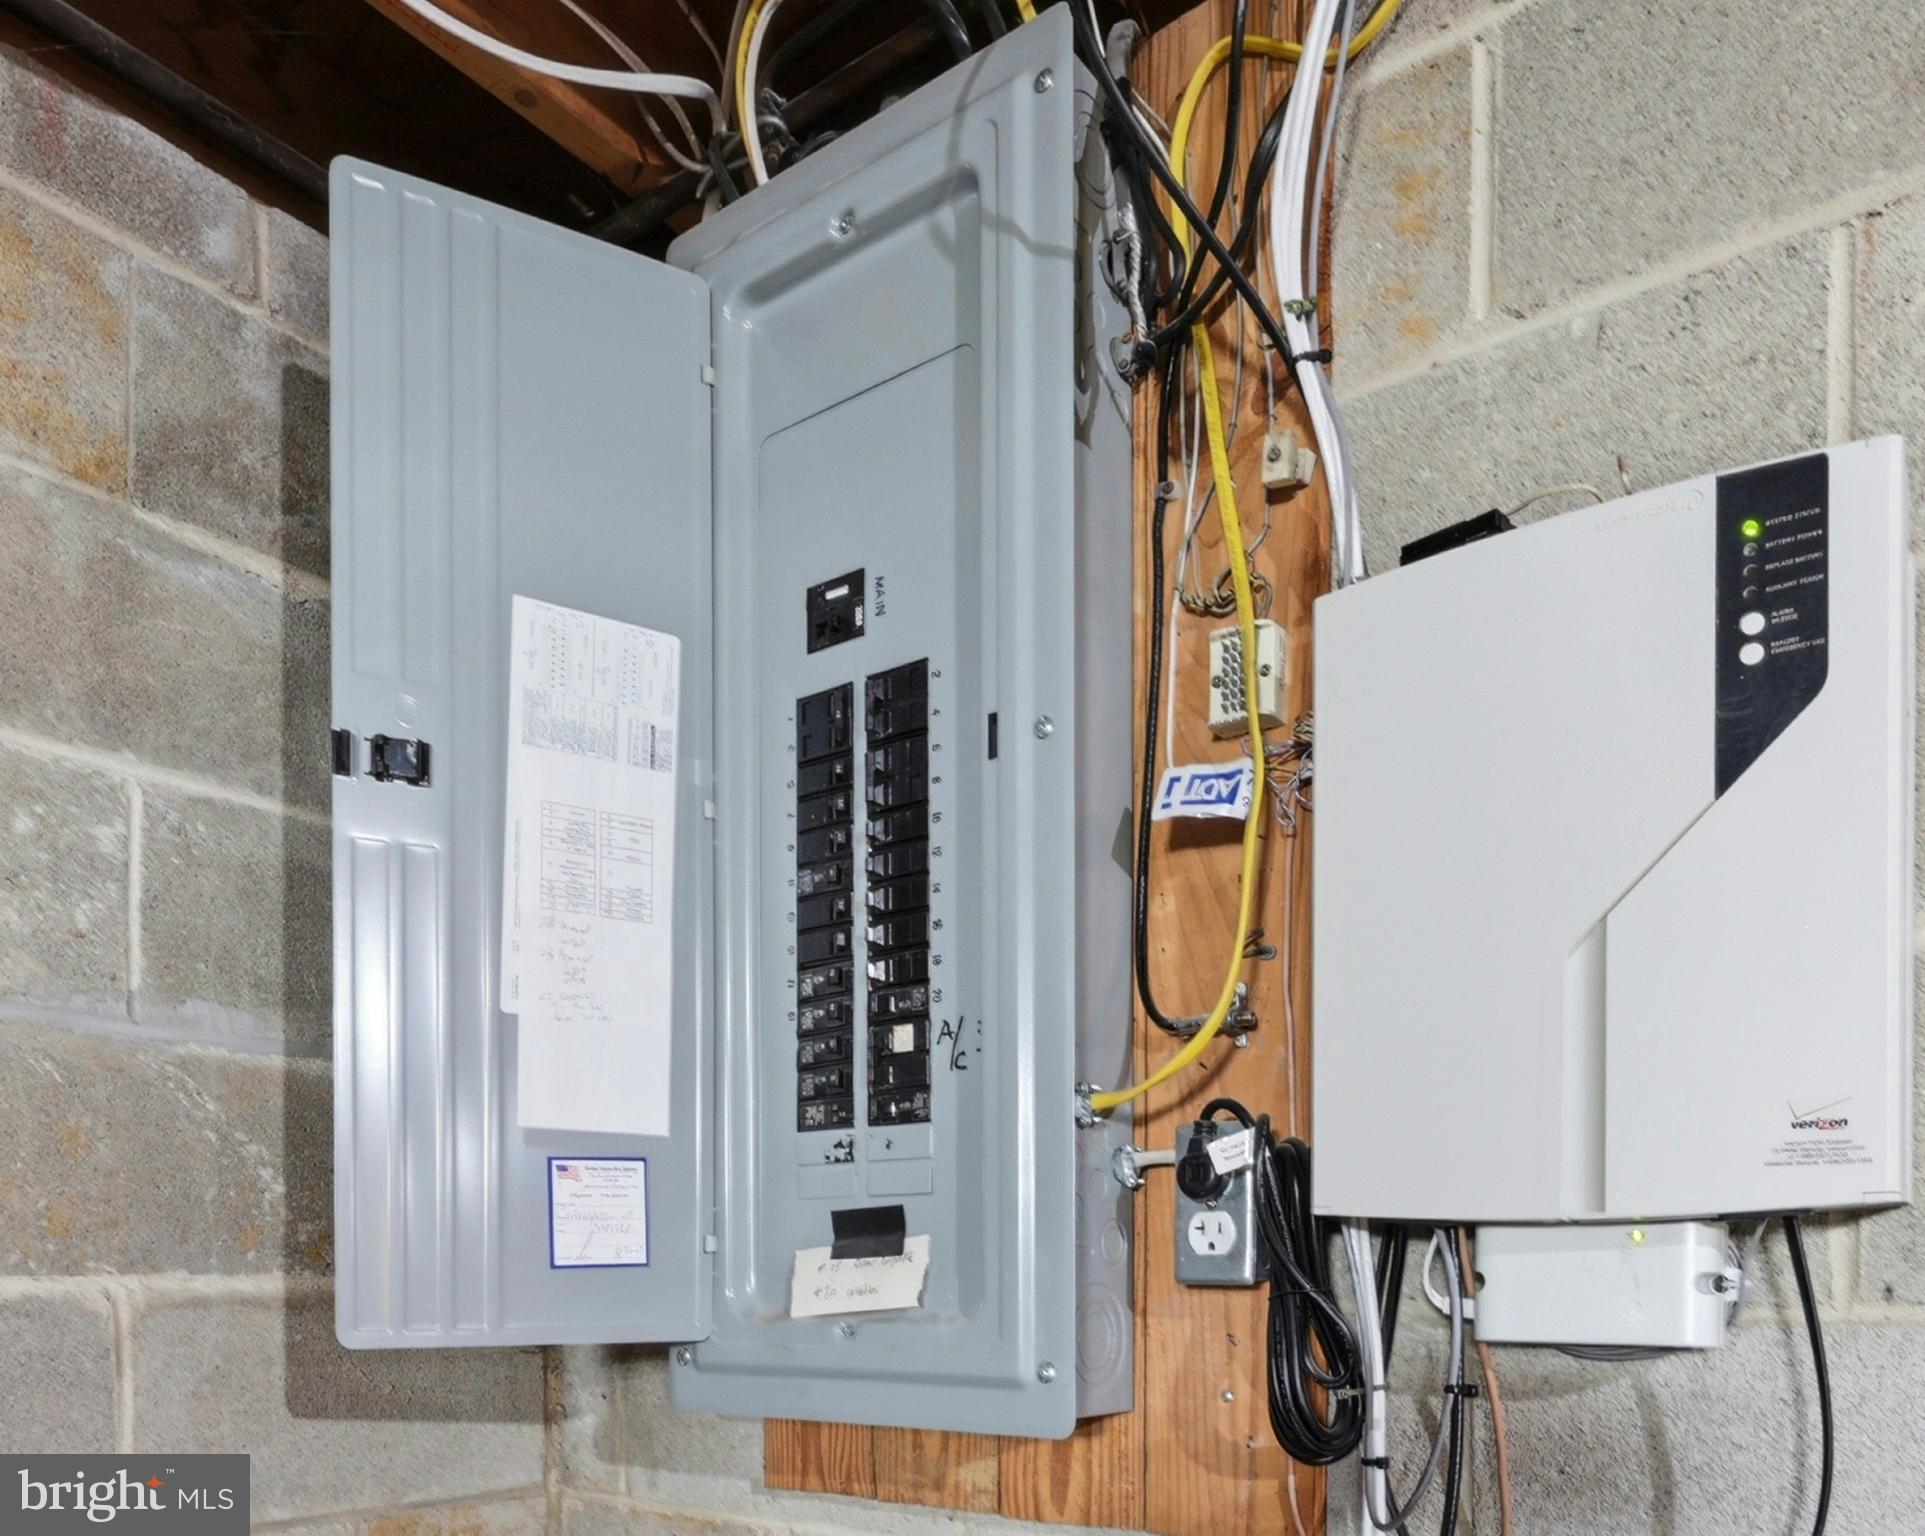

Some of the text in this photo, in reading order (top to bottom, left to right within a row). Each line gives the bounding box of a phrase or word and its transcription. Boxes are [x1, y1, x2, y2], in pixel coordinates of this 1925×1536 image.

[874, 575, 885, 617] MAIN
[930, 669, 942, 679] 2
[1184, 772, 1242, 802] ADT
[936, 1015, 969, 1072] A/C
[1791, 1117, 1848, 1130] verizon
